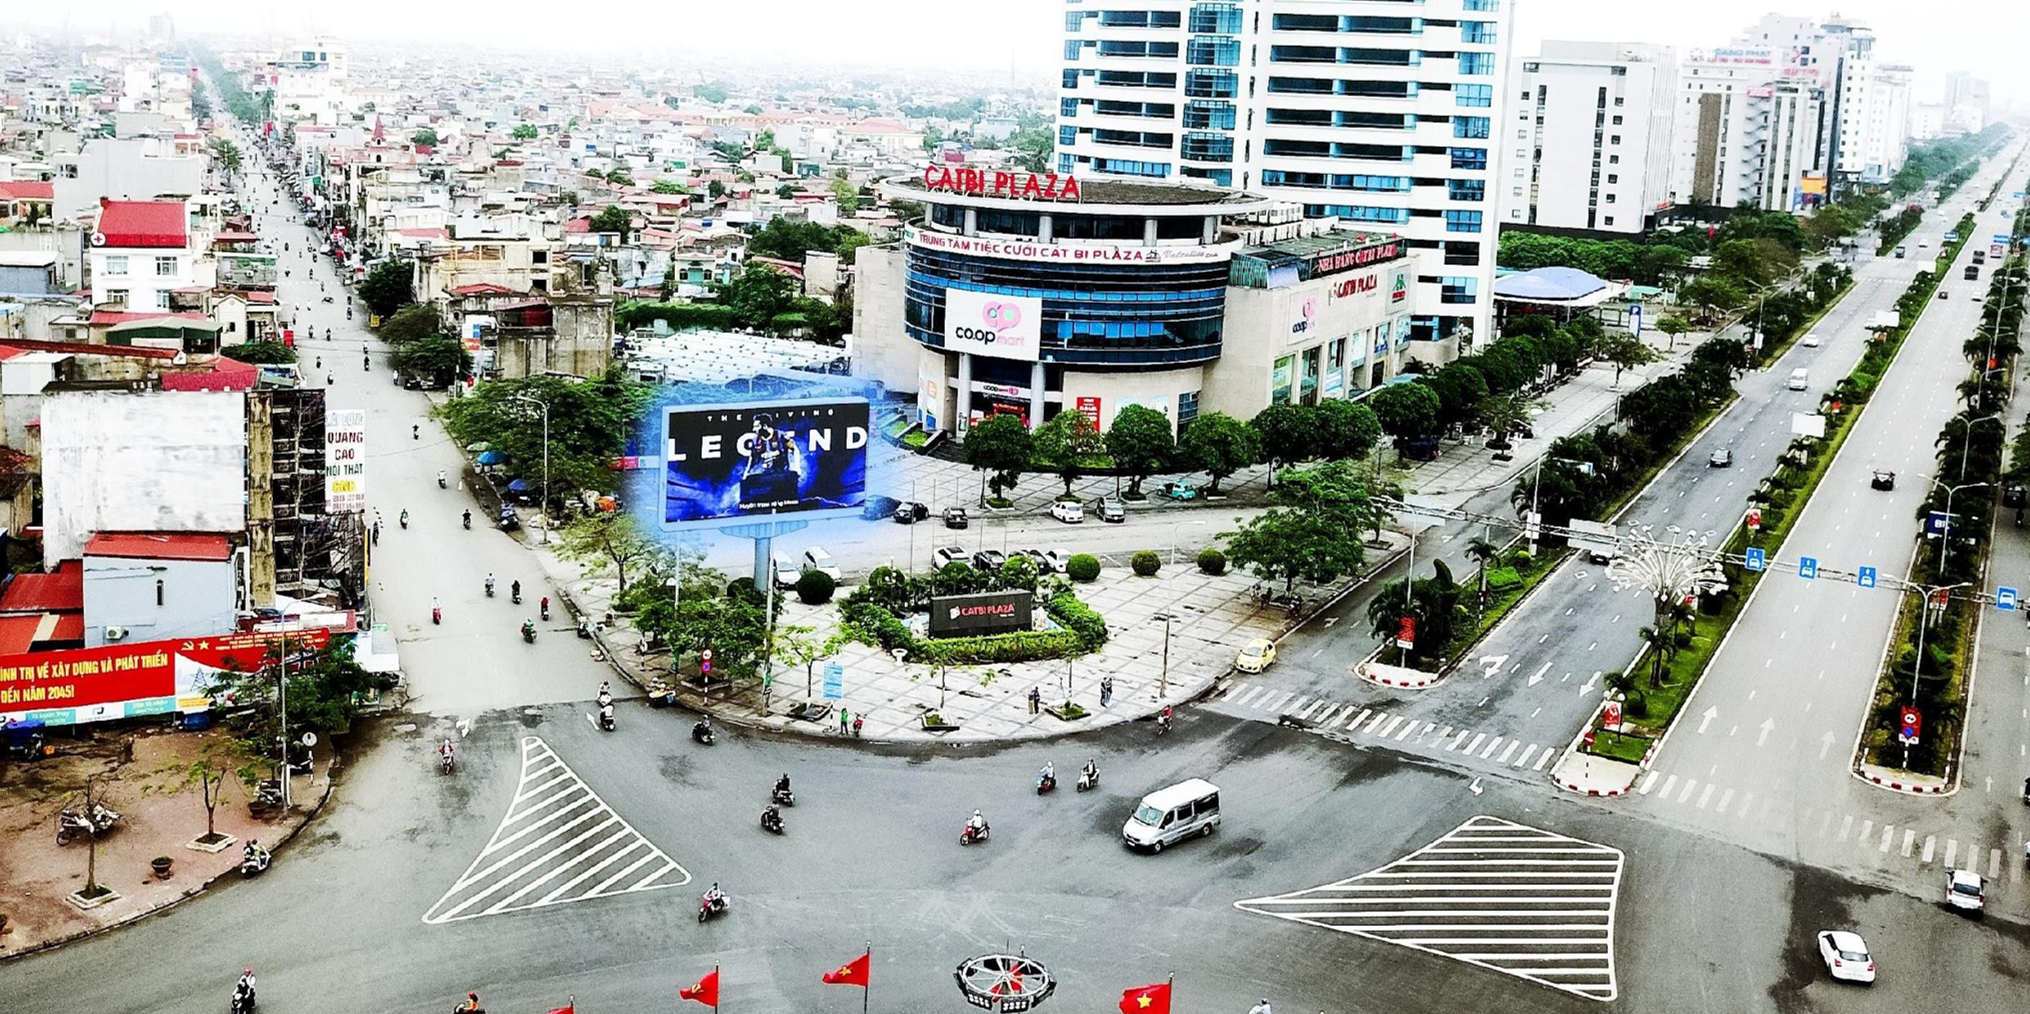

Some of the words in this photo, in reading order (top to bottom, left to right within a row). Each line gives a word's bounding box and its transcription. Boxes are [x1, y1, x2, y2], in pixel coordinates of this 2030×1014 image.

[925, 165, 985, 192] CATBI
[994, 171, 1080, 199] PLAZA
[919, 232, 946, 247] TRUNG
[973, 239, 1000, 257] TIỆC
[1074, 249, 1089, 259] BI
[1093, 249, 1143, 261] PLAZA
[707, 412, 743, 422] THE
[775, 408, 834, 419] IVING
[668, 426, 868, 462] LEGND
[961, 606, 986, 616] CATBI
[987, 603, 1015, 614] PLAZA
[20, 666, 35, 683] TRỊ
[52, 661, 71, 679] XÂY
[72, 660, 99, 679] DỰNG
[101, 656, 114, 673] VÀ
[115, 654, 140, 671] PHÁT
[141, 649, 168, 669] TRIỂN
[23, 684, 46, 702] NĂM
